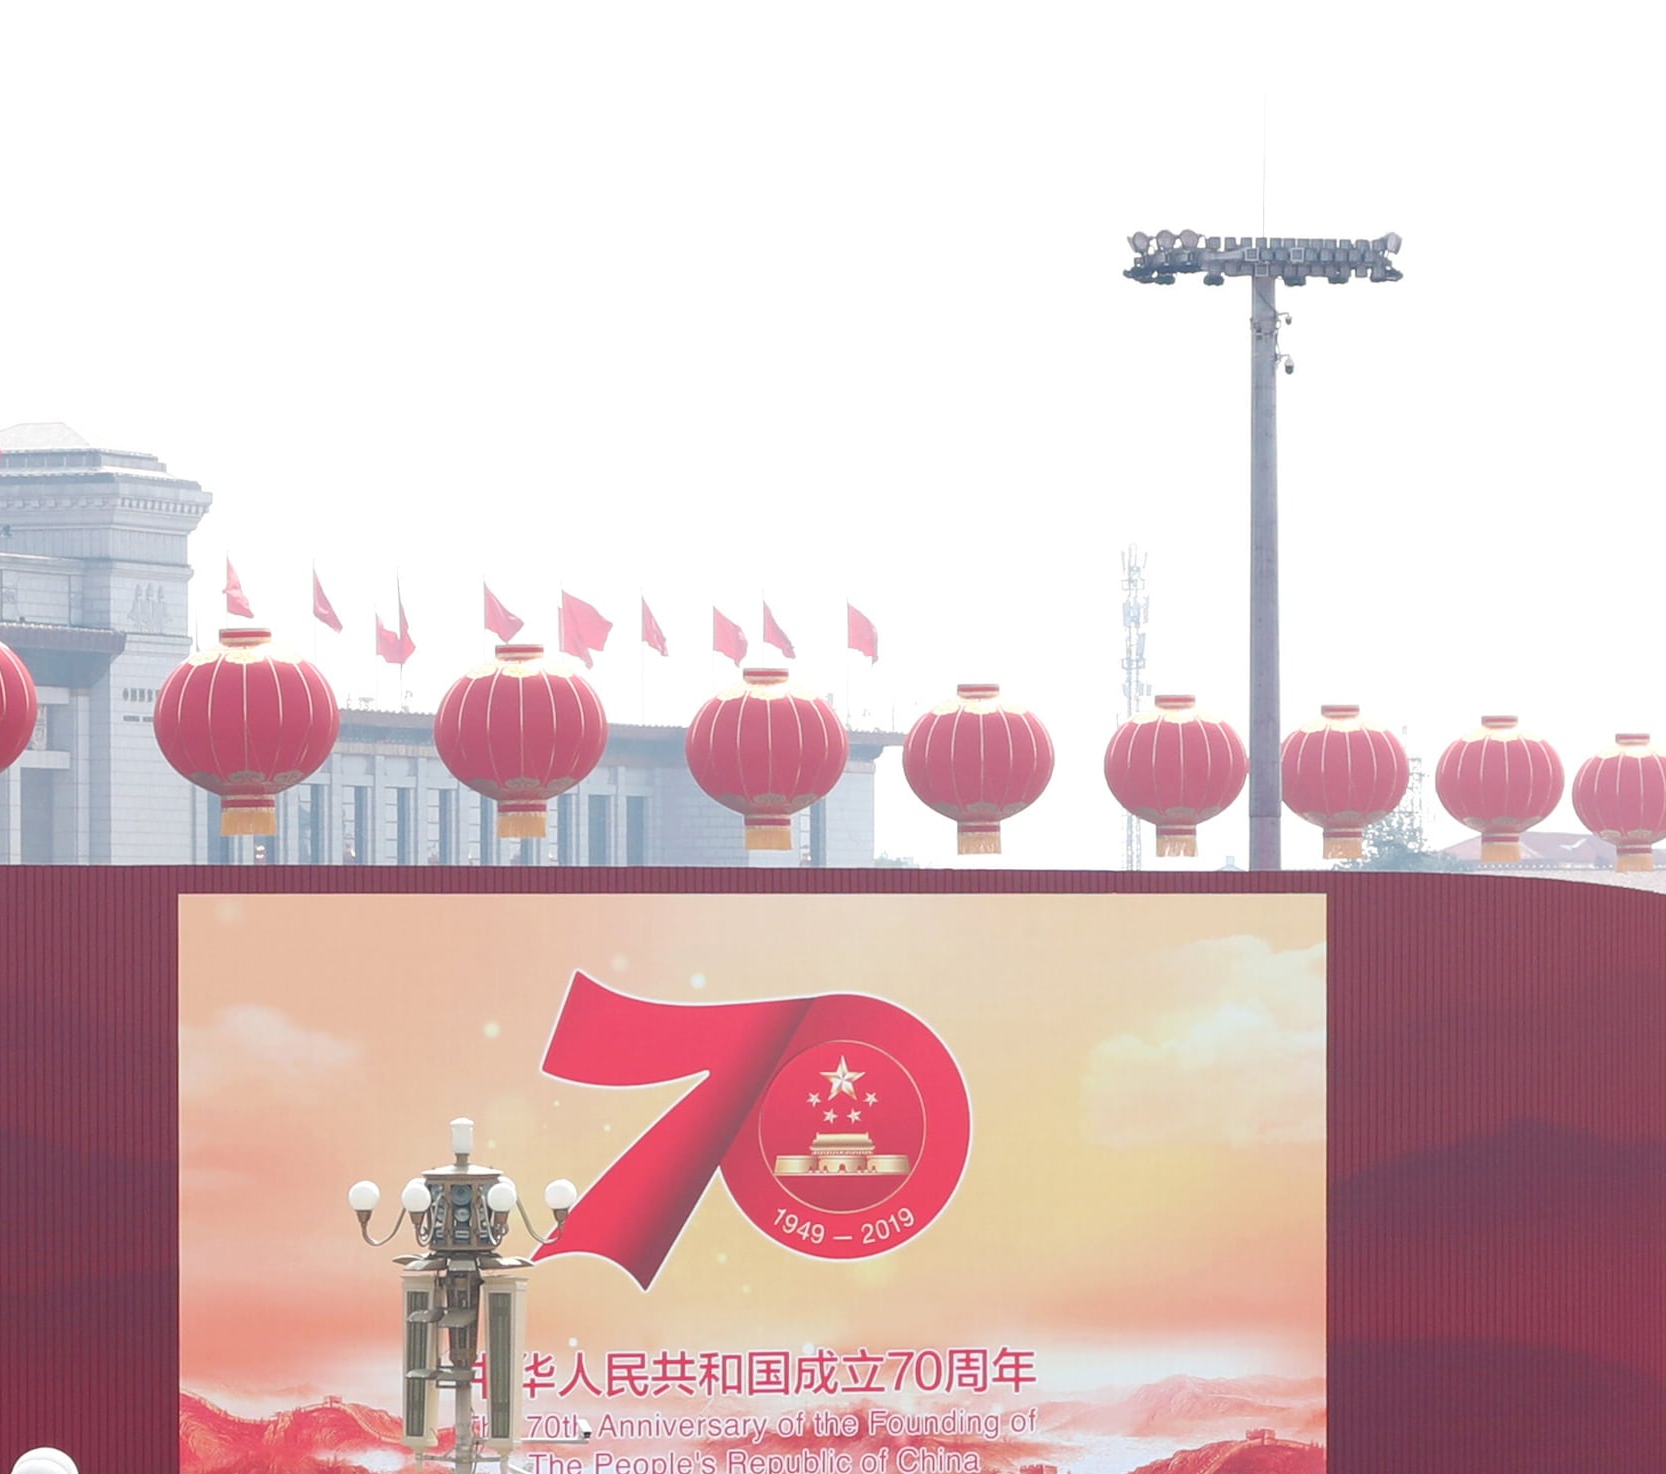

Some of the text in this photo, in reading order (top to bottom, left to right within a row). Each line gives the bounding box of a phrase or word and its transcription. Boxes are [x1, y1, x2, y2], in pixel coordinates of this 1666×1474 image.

[773, 1208, 825, 1244] 1949
[860, 1207, 915, 1244] 2019
[599, 1413, 767, 1443] Anniversary
[778, 1412, 804, 1436] of
[815, 1411, 859, 1434] the
[870, 1409, 1000, 1439] Founding
[1011, 1408, 1037, 1432] of
[861, 1448, 887, 1474] of
[897, 1448, 980, 1474] China
